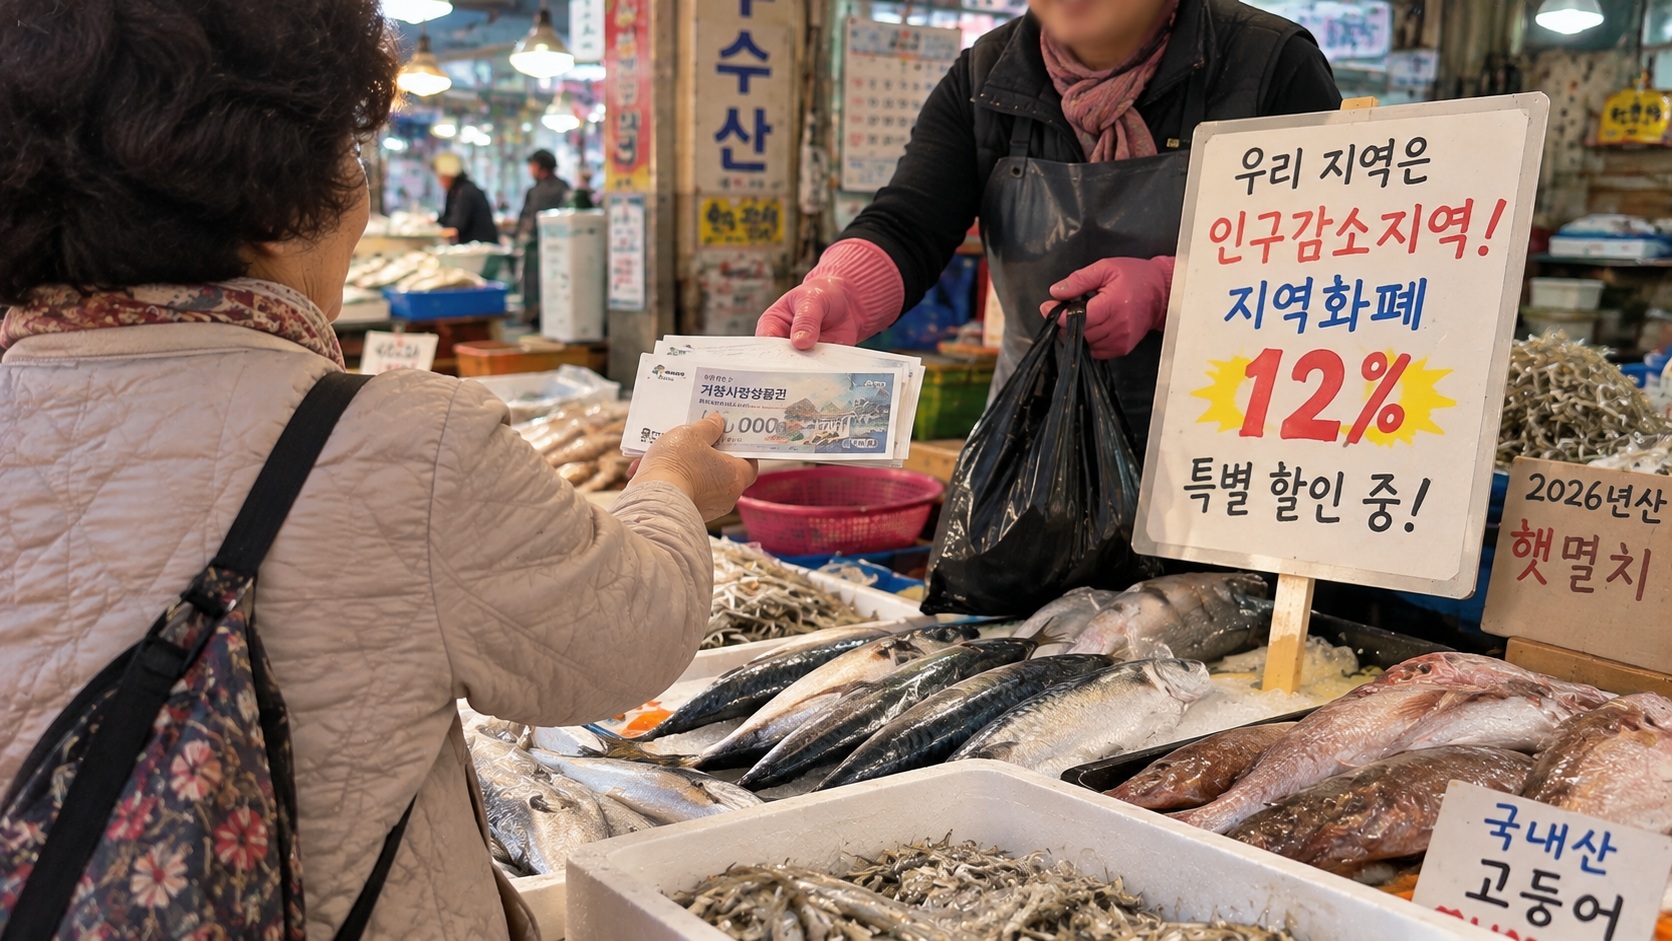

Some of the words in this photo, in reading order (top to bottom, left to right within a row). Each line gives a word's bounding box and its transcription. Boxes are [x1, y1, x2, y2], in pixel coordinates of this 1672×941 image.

[714, 0, 773, 173] 수산
[1234, 146, 1303, 196] 우리
[1319, 136, 1431, 189] 지역은
[1209, 197, 1508, 265] 인구감소지역!
[1223, 273, 1428, 335] 지역화폐
[1239, 348, 1412, 447] 12%
[1183, 456, 1253, 517] 특별
[1269, 460, 1345, 524] 할인
[1362, 473, 1432, 533] 중!
[1525, 472, 1669, 525] 2026년산
[1510, 518, 1652, 602] 햇멸치
[1483, 802, 1618, 876] 국내산
[1464, 857, 1624, 941] 고등어
